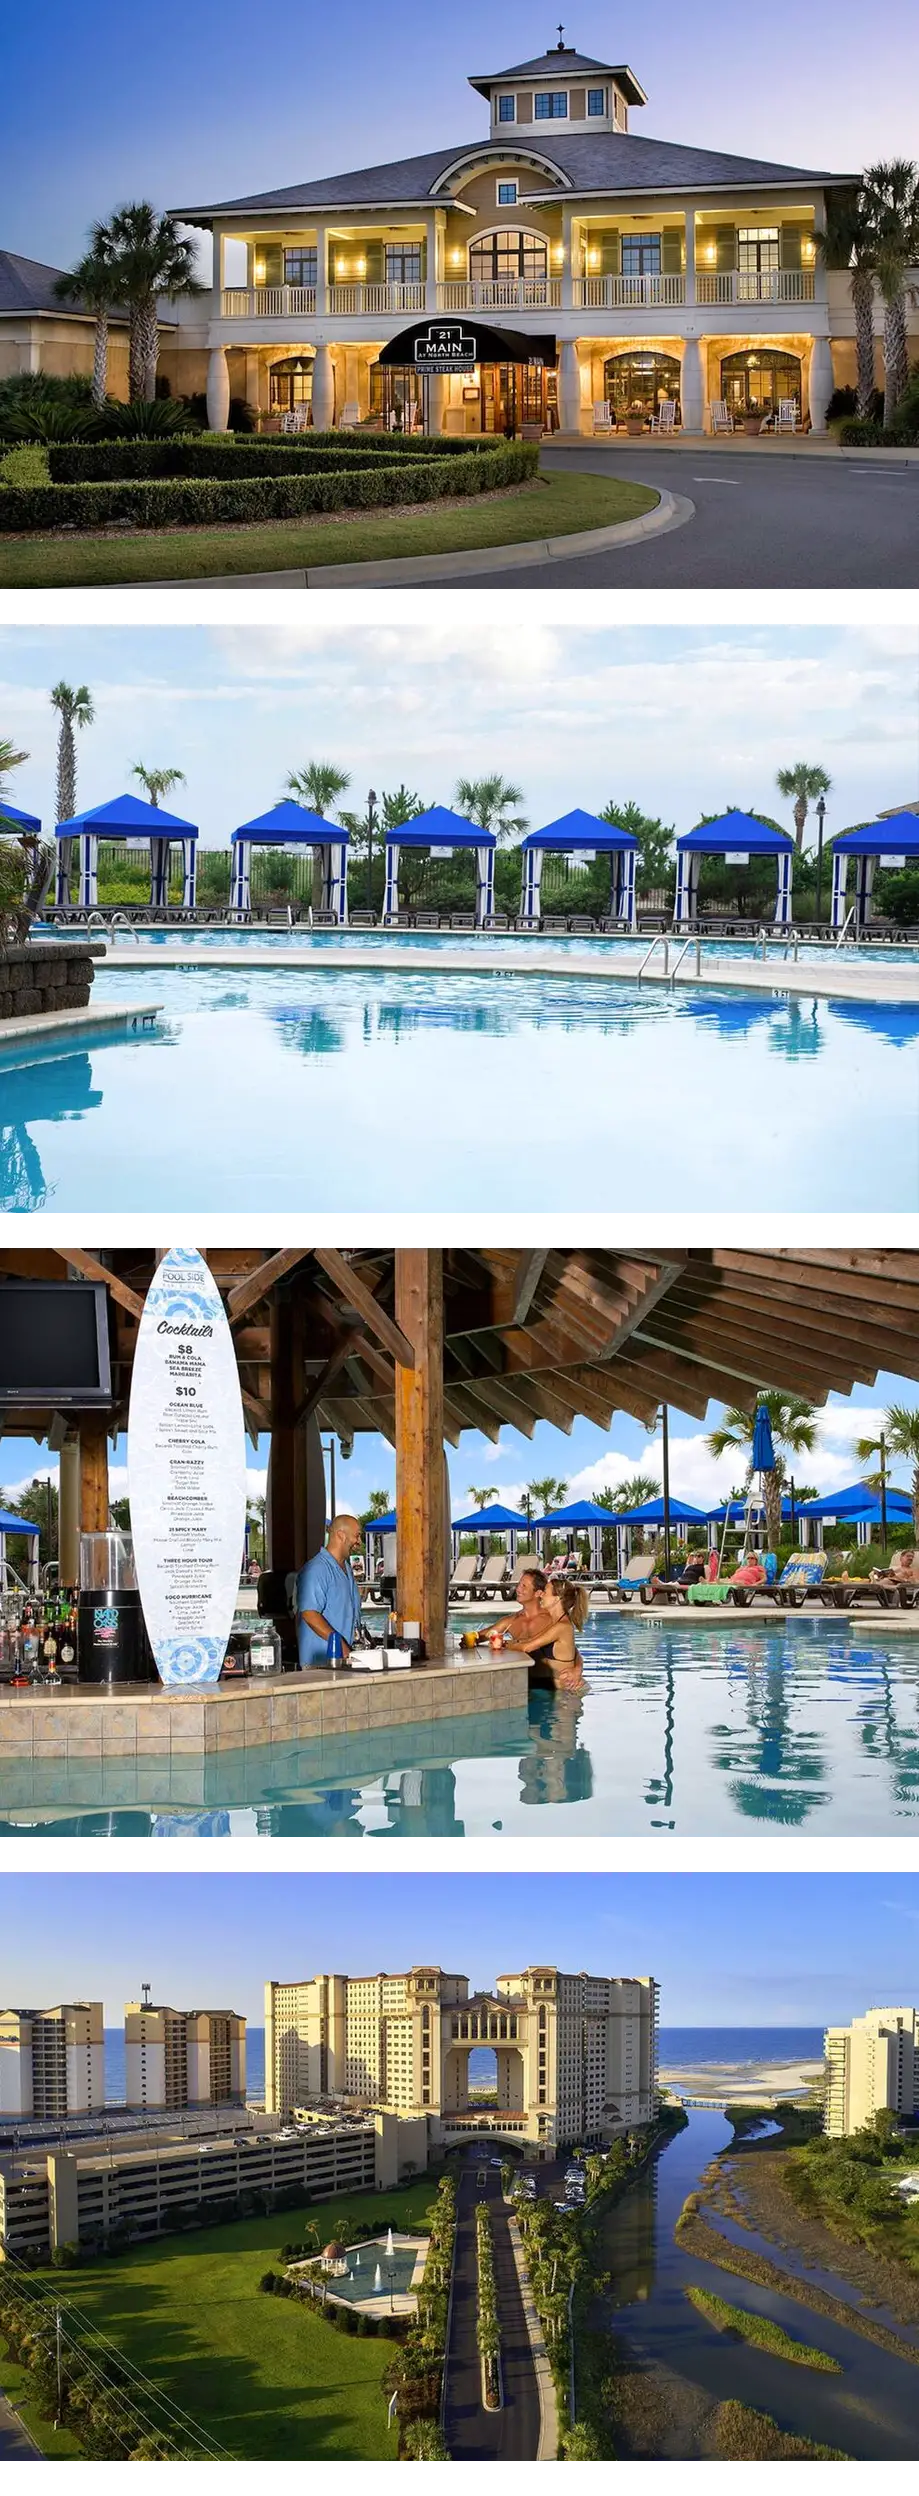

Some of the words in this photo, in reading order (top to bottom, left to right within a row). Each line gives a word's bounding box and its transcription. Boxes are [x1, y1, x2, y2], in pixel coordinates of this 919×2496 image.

[426, 343, 462, 352] MAIN
[163, 1272, 185, 1280] POOL
[157, 1320, 213, 1337] Cocktails
[178, 1344, 192, 1354] $8
[176, 1387, 196, 1396] $10
